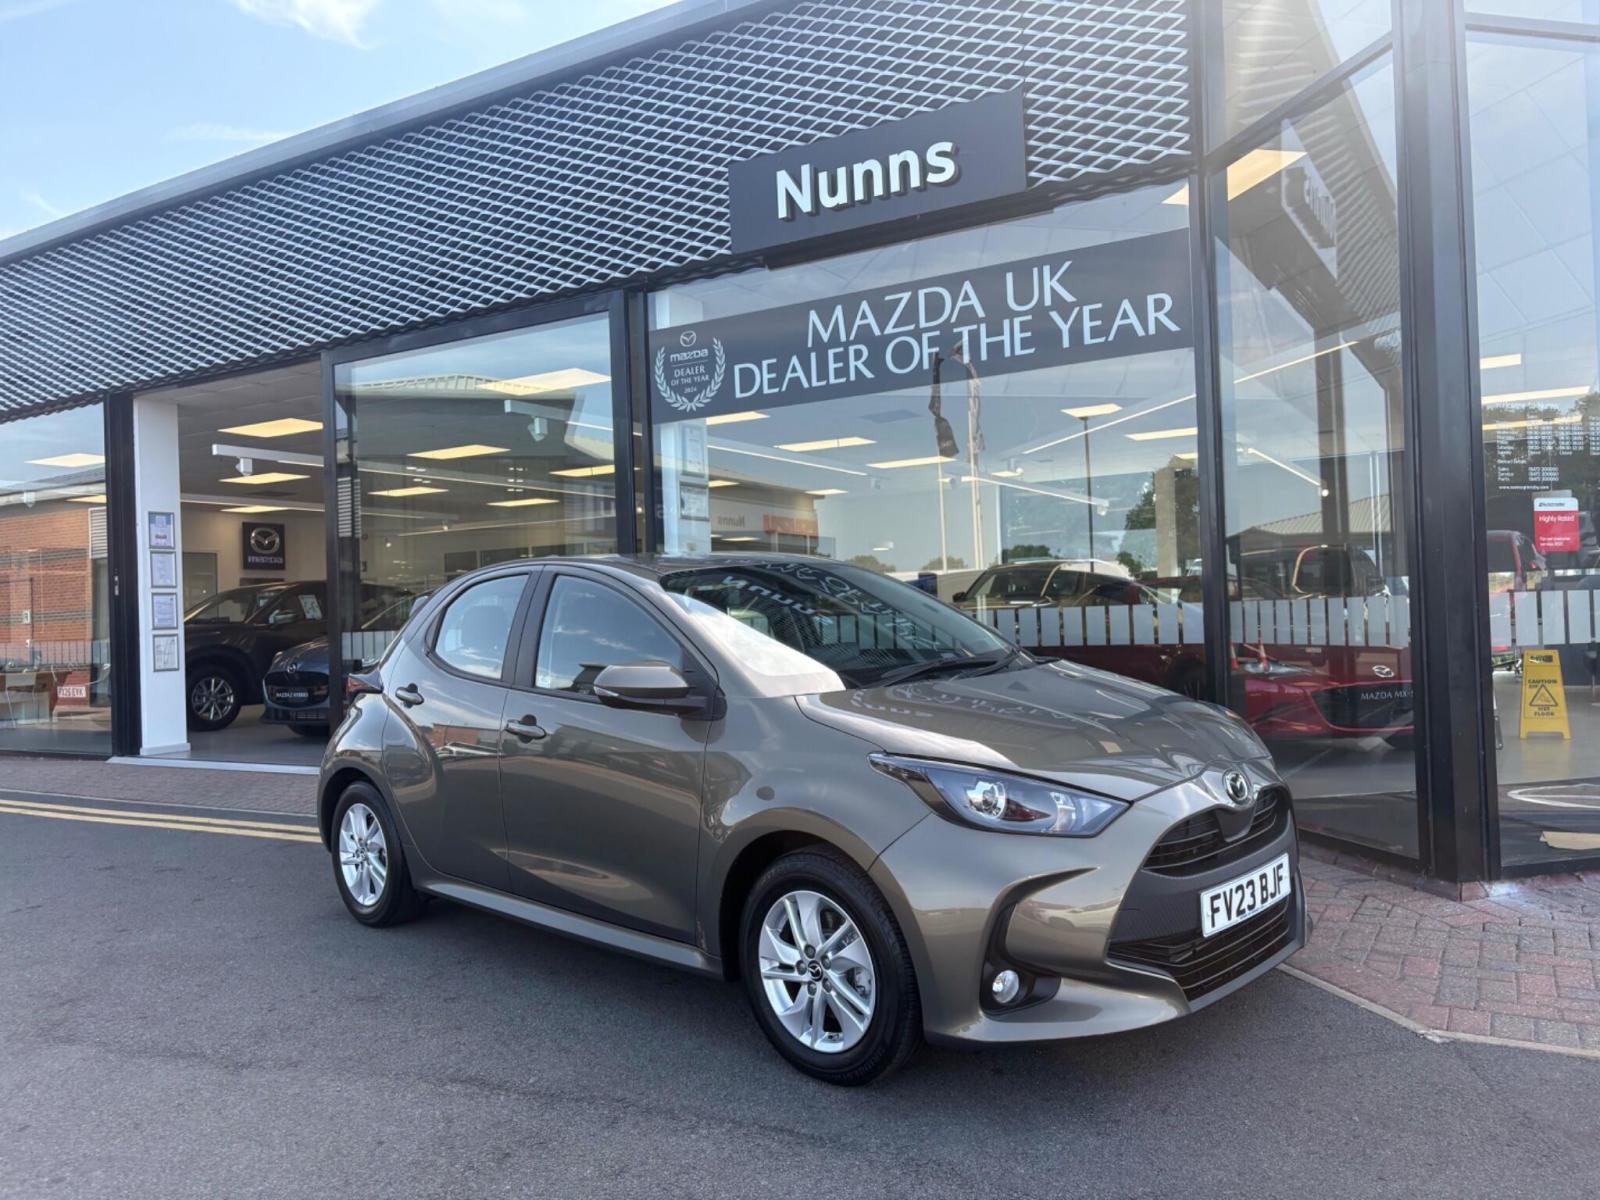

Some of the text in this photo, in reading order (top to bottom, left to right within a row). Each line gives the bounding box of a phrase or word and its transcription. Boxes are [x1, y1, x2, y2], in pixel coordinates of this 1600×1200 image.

[776, 141, 957, 220] Nunns
[807, 260, 1077, 348] MAZDA UK
[734, 292, 1181, 398] DEALER OF THE YEAR
[674, 366, 705, 378] DEALER
[693, 374, 710, 383] YEAR
[1539, 515, 1556, 523] Highly
[1361, 691, 1392, 700] MAZDA
[1210, 862, 1284, 928] FV23 BJF
